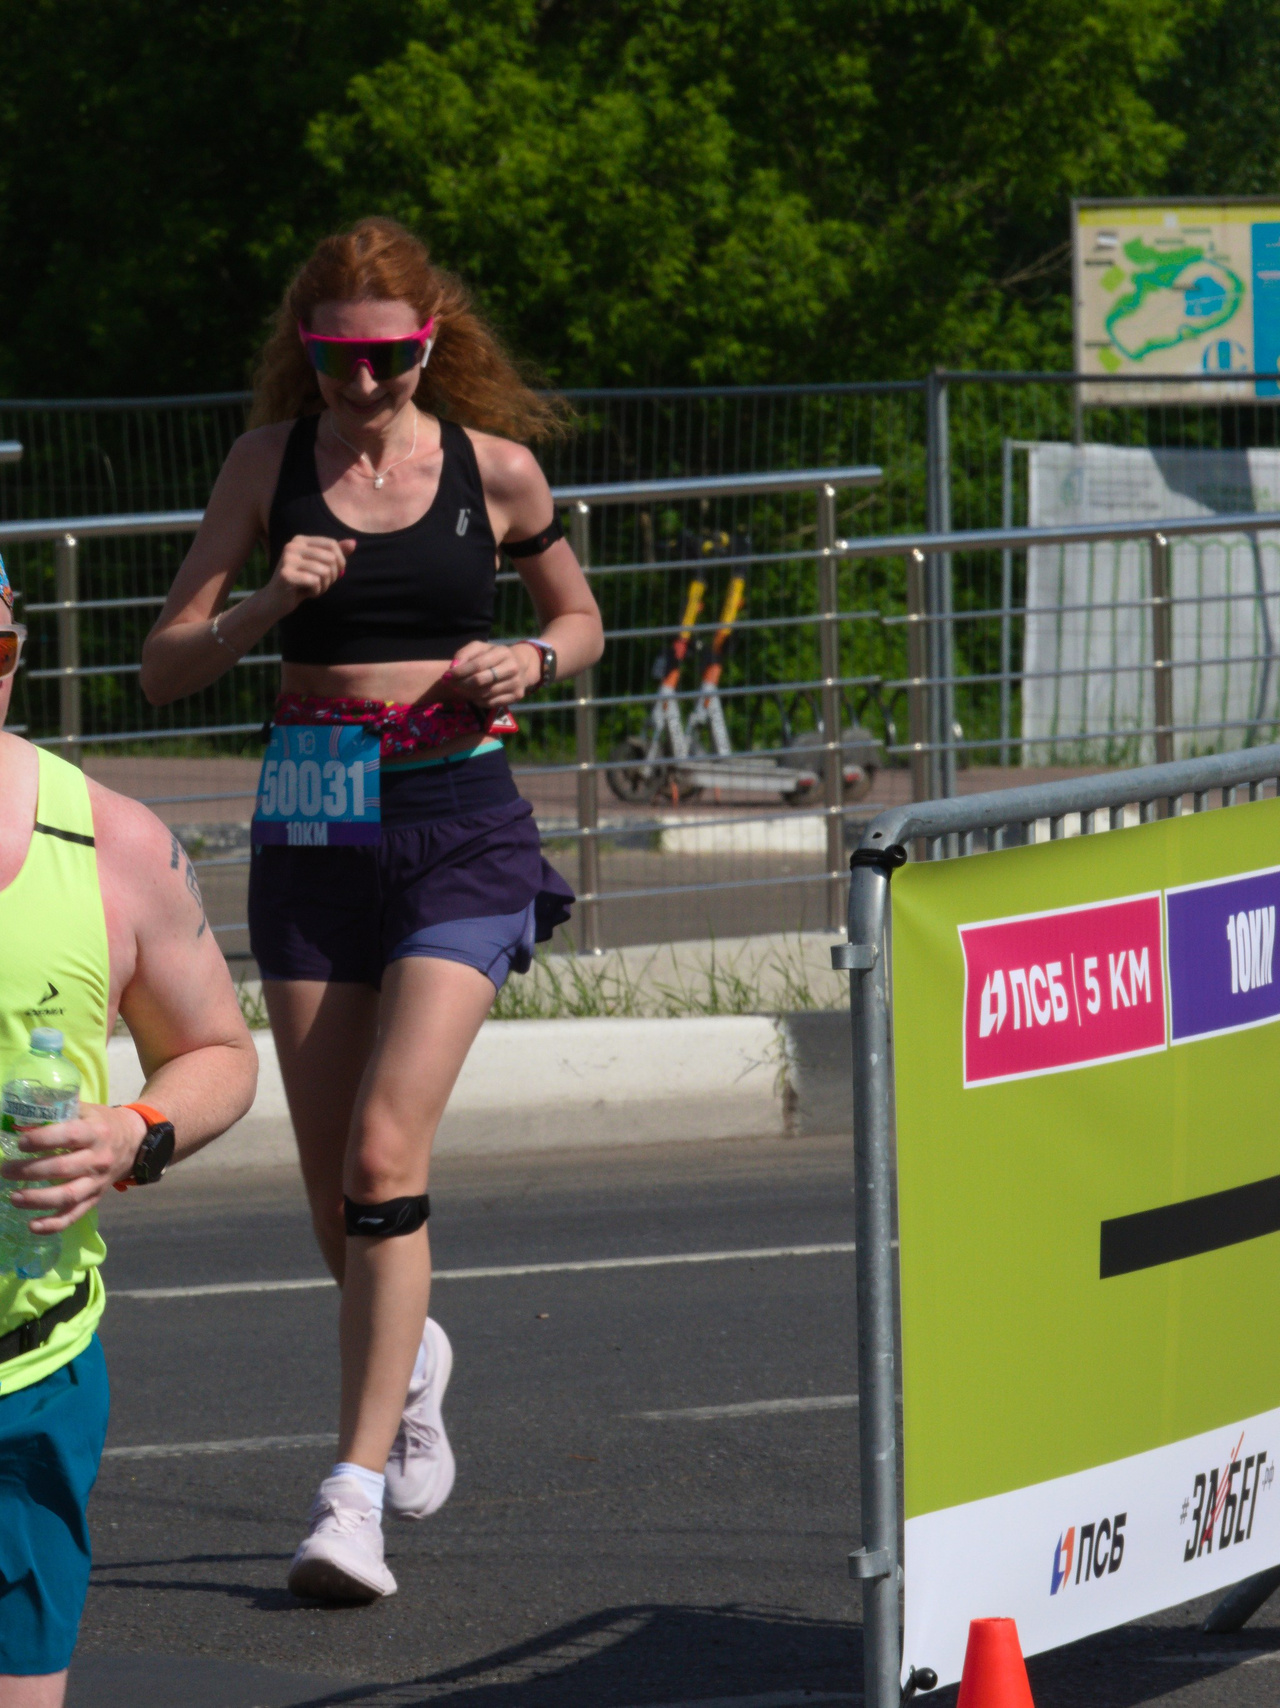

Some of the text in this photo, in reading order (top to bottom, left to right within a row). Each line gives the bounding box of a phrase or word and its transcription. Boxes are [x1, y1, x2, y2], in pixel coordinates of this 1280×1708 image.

[261, 760, 365, 817] 50031
[1009, 947, 1152, 1029] ПСБ 5 КМ
[1075, 1512, 1127, 1586] ПСБ
